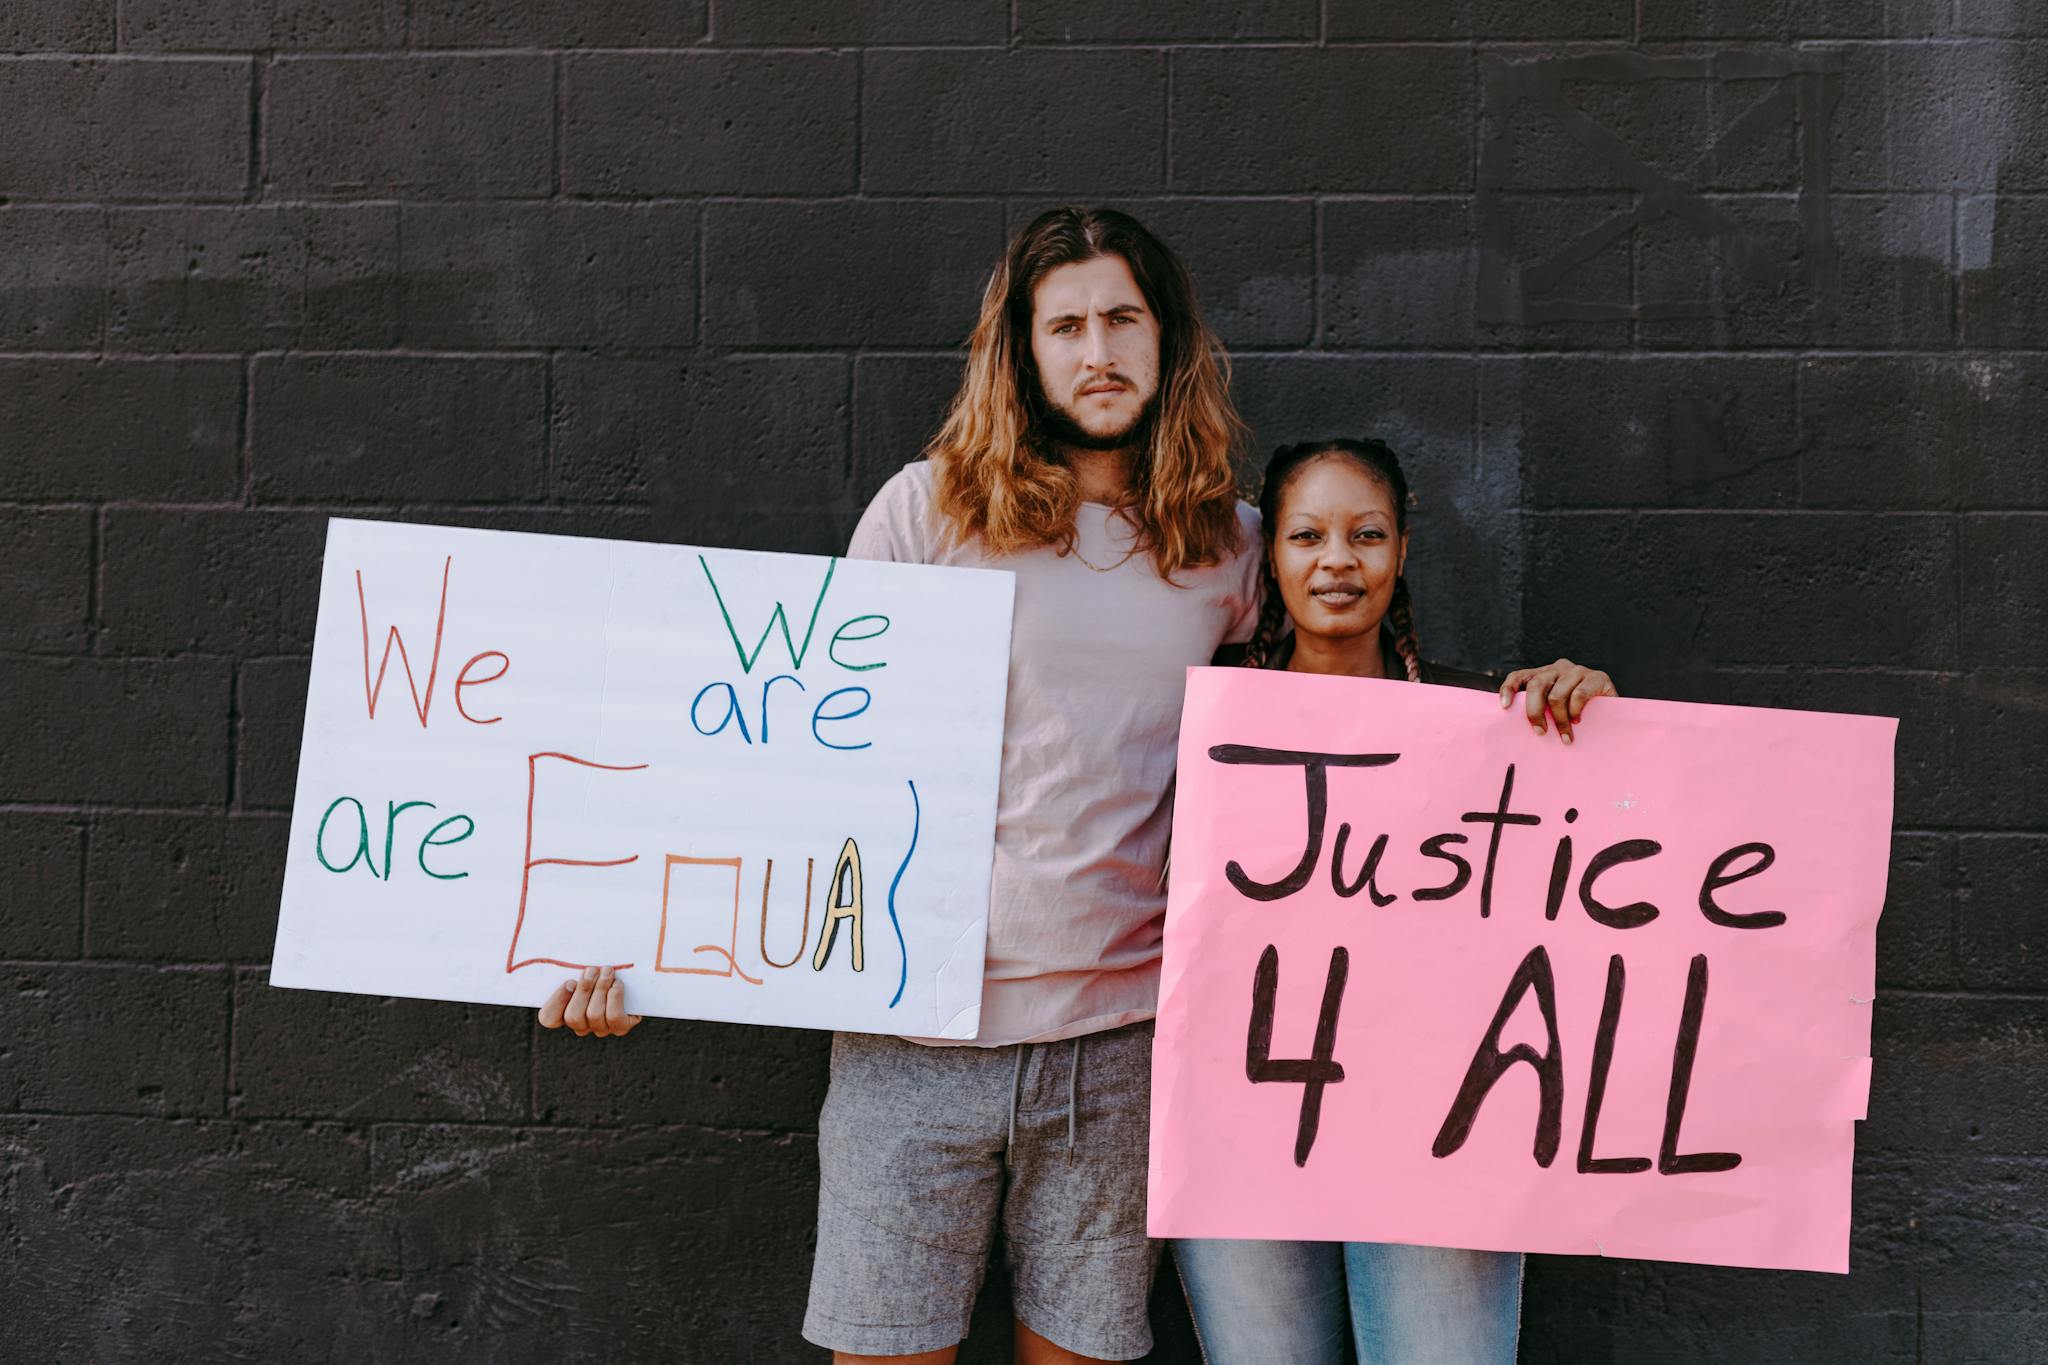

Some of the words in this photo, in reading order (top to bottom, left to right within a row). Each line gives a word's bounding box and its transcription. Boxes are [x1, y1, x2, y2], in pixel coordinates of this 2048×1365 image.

[356, 556, 509, 727] We
[699, 555, 890, 675] We
[690, 675, 873, 750] are
[316, 796, 475, 881] are
[1208, 743, 1787, 930] Justice
[1245, 943, 1349, 1168] 4
[1431, 944, 1743, 1176] ALL
